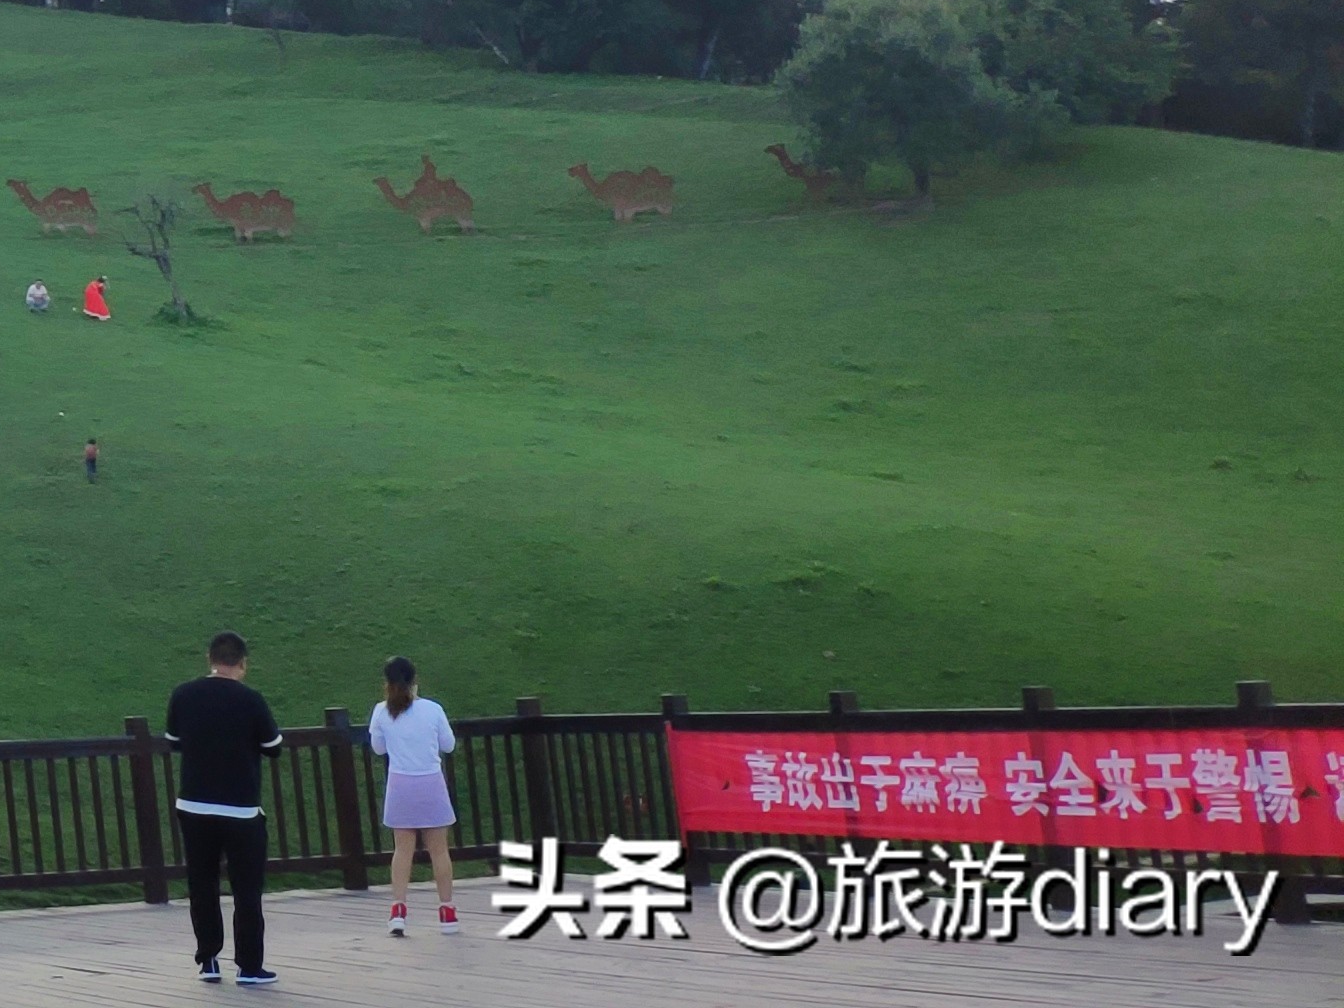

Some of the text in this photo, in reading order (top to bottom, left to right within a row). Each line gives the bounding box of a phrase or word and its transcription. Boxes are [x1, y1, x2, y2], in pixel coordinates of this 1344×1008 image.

[745, 749, 988, 815] 事故出于麻痹
[1004, 748, 1301, 824] 安全来于警惕
